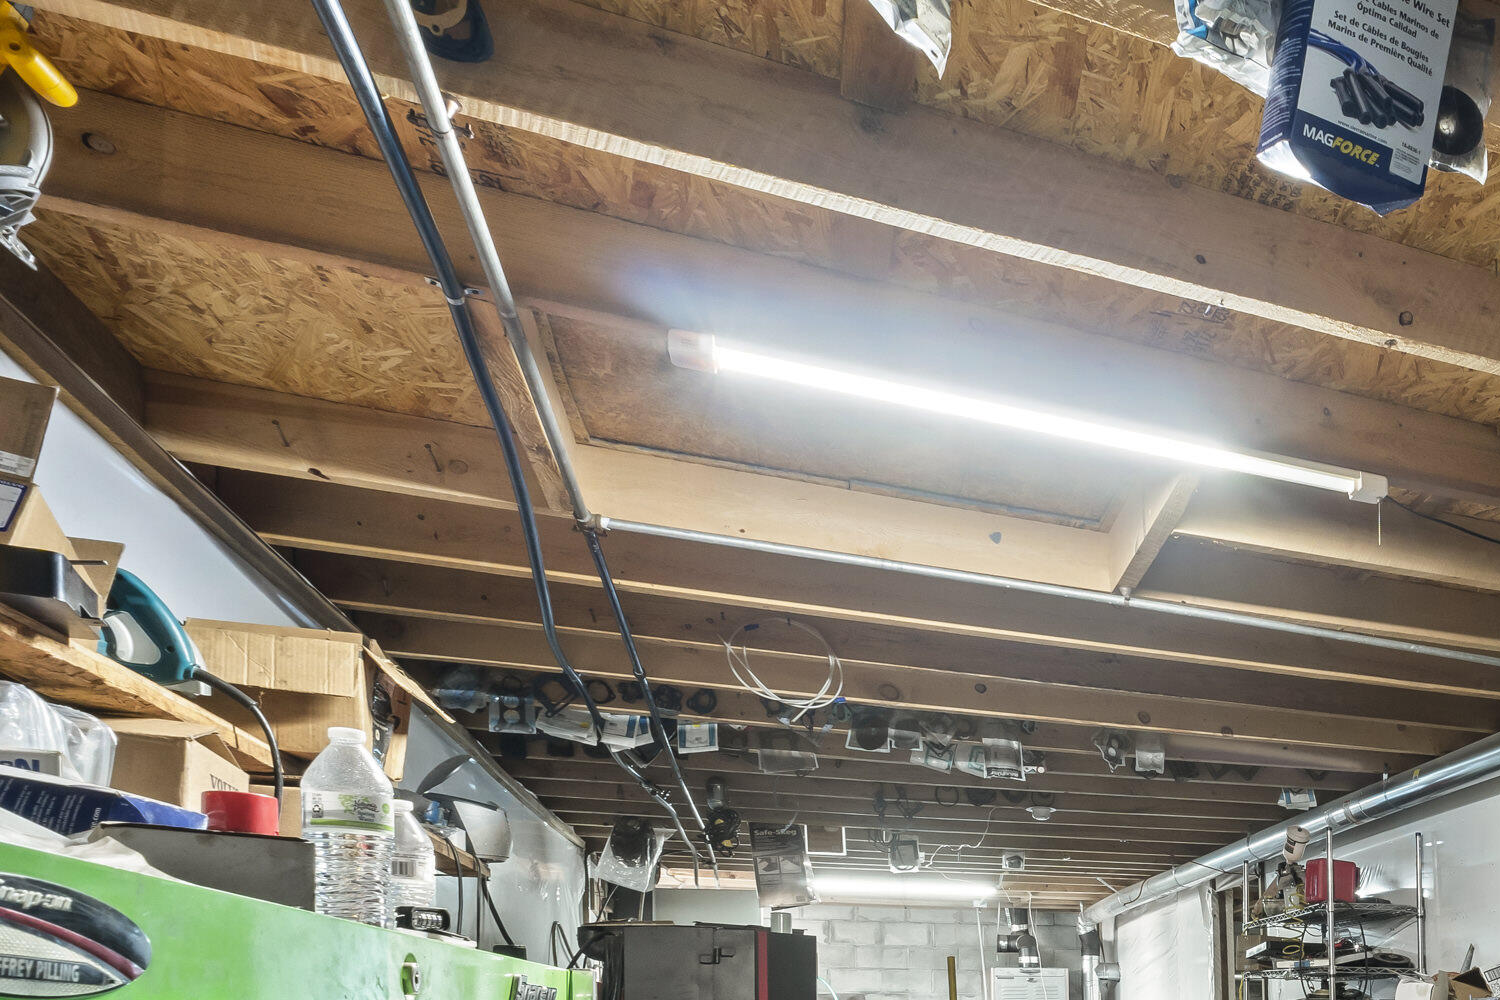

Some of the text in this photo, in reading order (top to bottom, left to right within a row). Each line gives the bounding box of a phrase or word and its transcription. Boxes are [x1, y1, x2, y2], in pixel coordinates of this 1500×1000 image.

[1389, 17, 1417, 38] Calidad
[1400, 11, 1429, 33] Marinos
[1430, 28, 1440, 39] de
[1413, 0, 1451, 28] Wire Set
[1328, 20, 1433, 77] Marins de Première Qualité
[1334, 10, 1429, 62] Set de Câbles de Bougies
[1303, 123, 1380, 166] MAGFORCE
[0, 879, 73, 912] nap-on
[36, 960, 81, 982] PILLING
